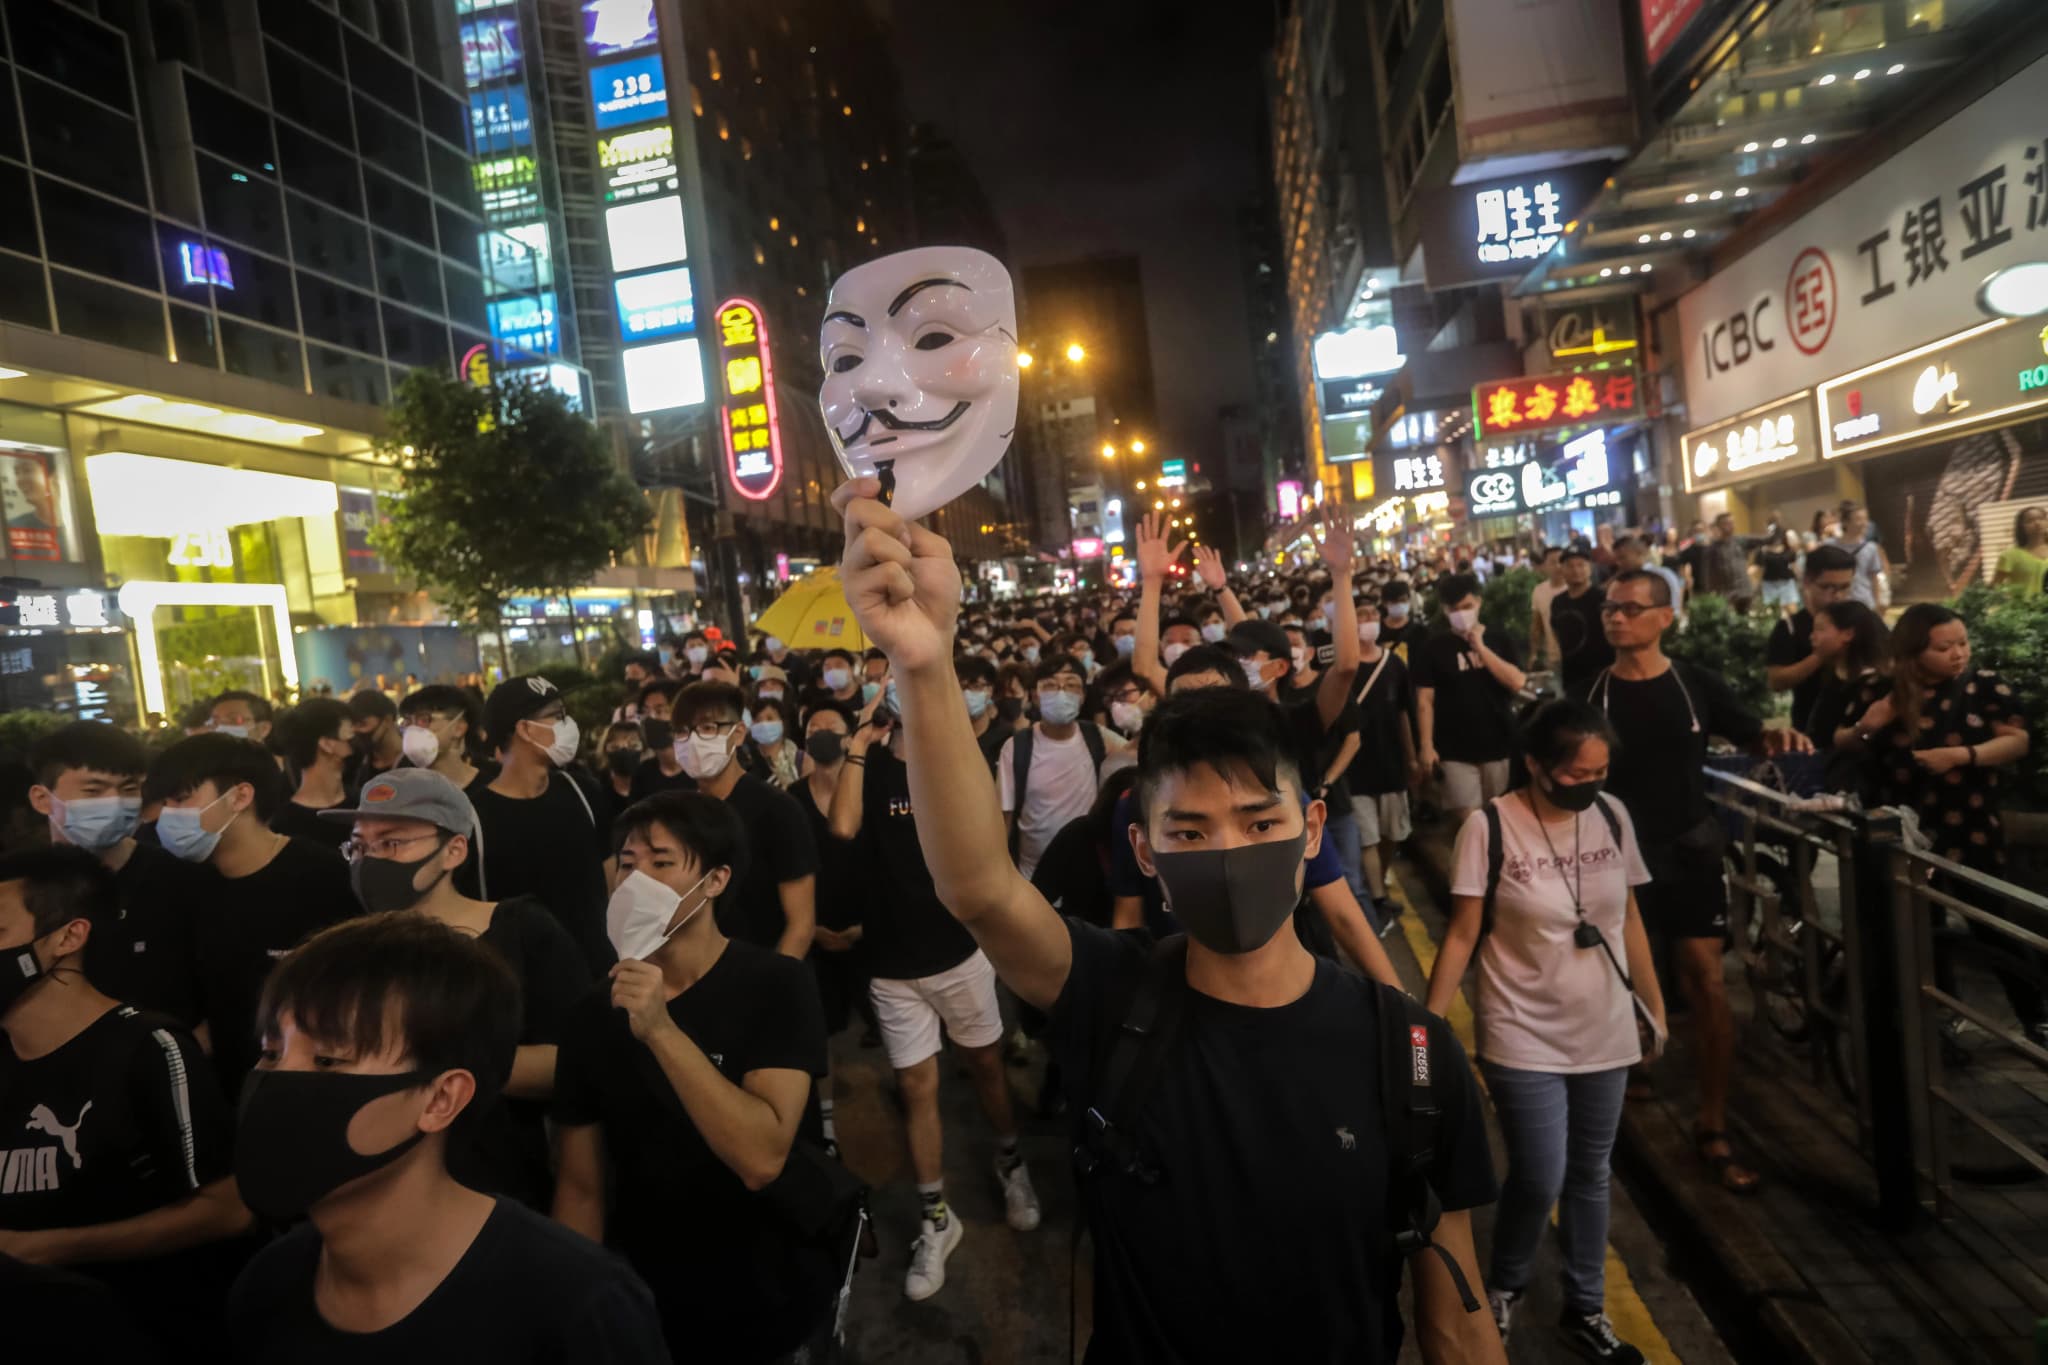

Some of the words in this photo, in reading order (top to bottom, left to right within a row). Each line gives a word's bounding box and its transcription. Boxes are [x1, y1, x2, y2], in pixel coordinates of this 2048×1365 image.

[611, 73, 652, 98] 238
[1702, 297, 1775, 380] ICBC
[0, 1146, 60, 1194] MA
